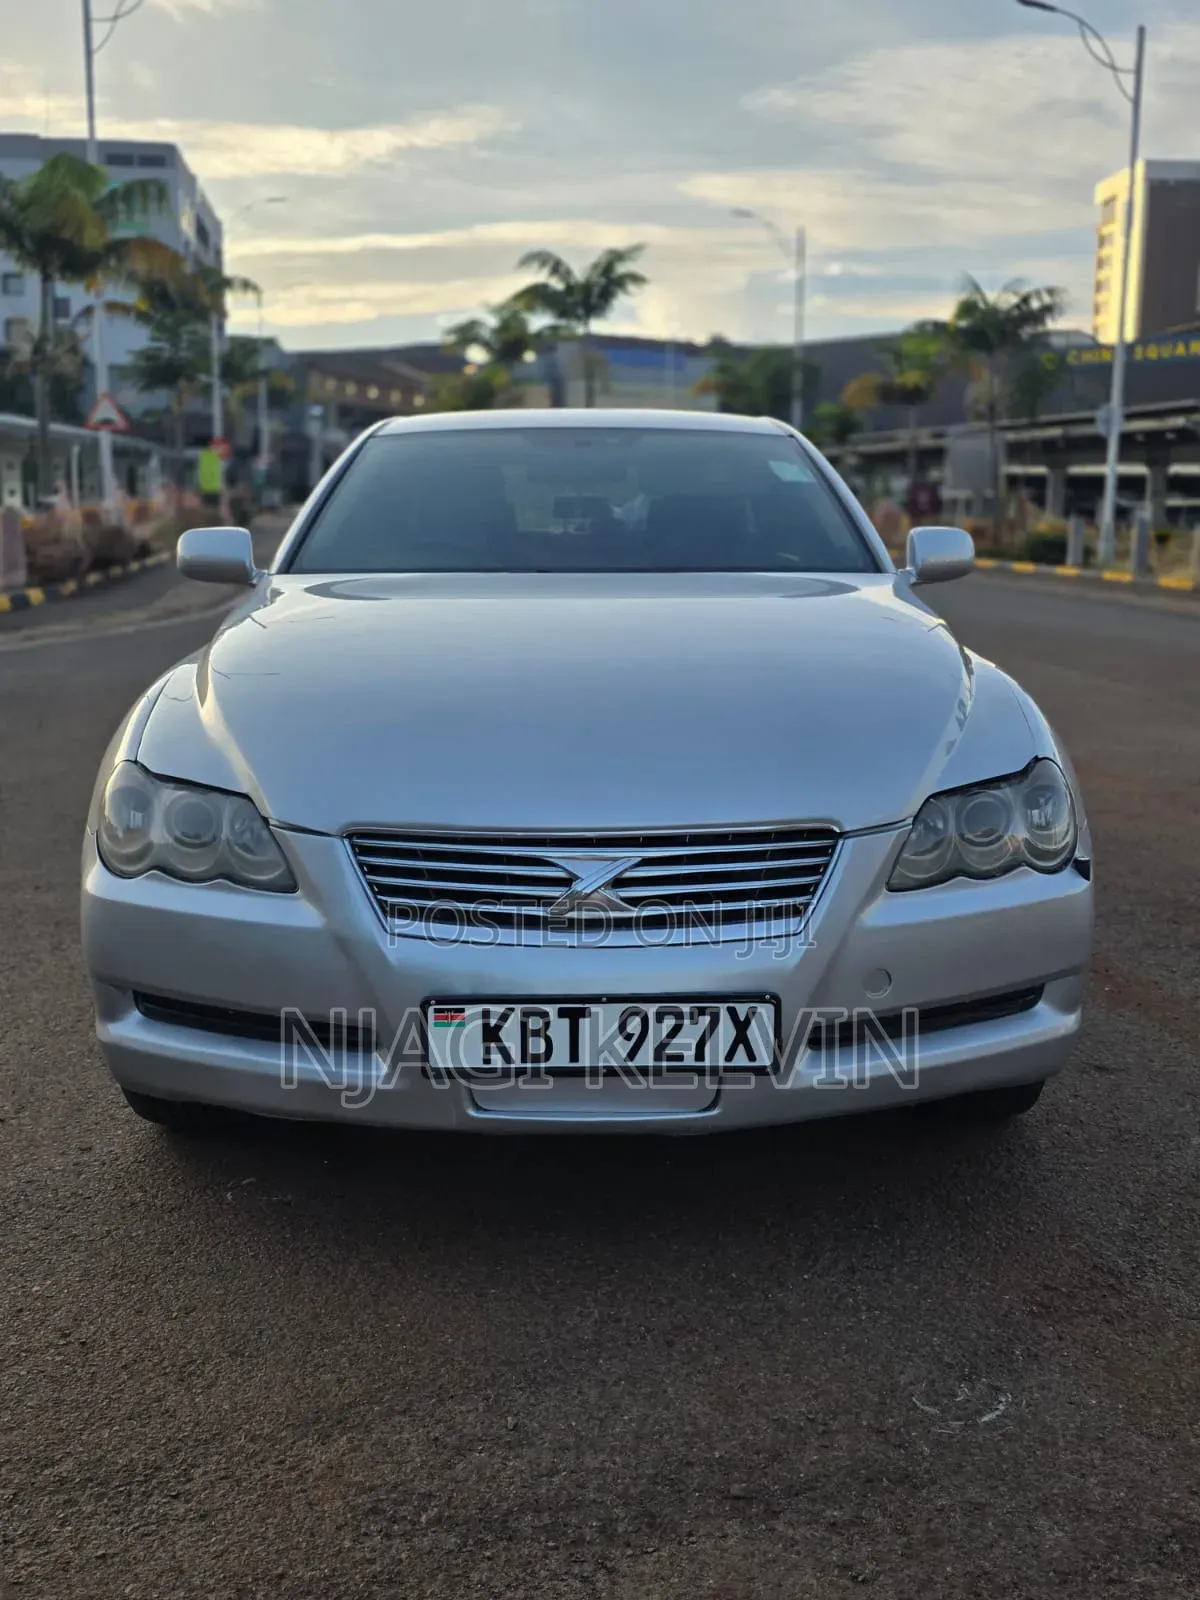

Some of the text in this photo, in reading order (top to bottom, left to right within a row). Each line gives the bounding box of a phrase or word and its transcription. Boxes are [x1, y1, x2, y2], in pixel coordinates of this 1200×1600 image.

[1066, 347, 1114, 366] CHIN
[481, 1005, 758, 1065] KBT 927X
